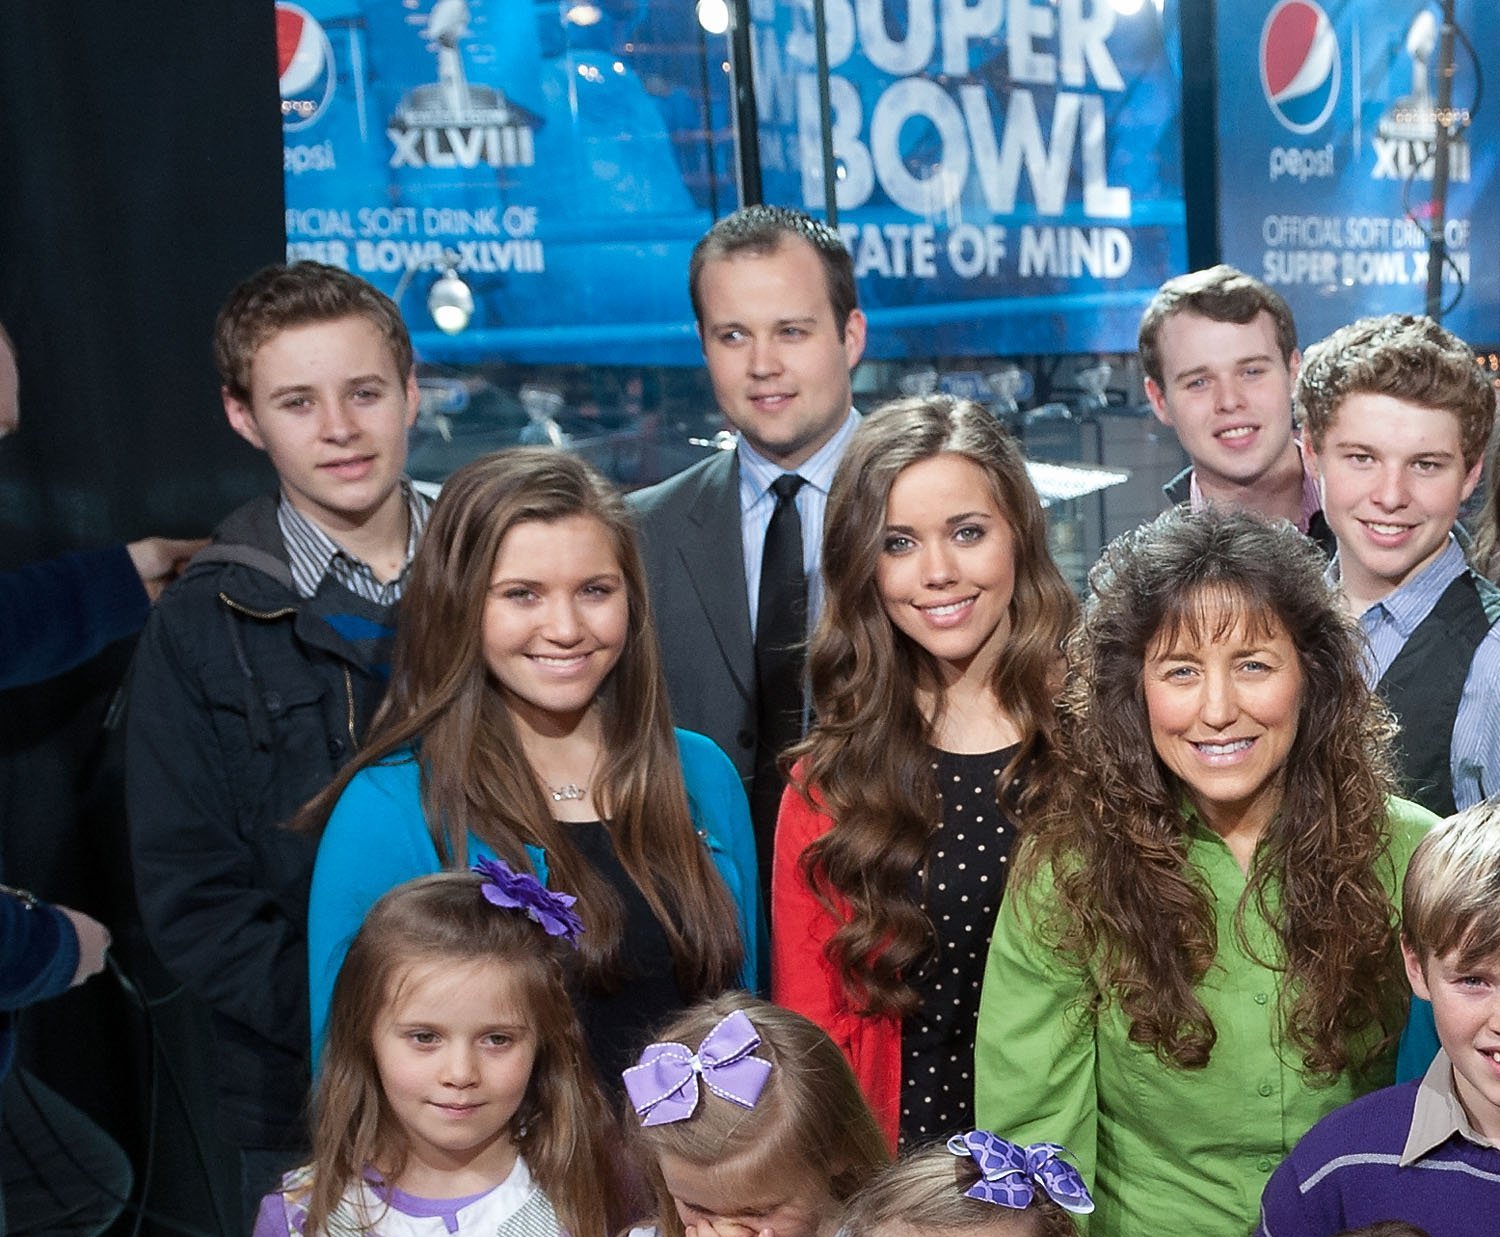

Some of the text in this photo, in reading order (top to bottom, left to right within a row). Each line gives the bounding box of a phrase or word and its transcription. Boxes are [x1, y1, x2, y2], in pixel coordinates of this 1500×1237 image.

[387, 126, 535, 169] XLVIII
[798, 74, 1131, 218] BOWL
[1269, 143, 1334, 183] pepsi
[358, 207, 417, 236] SOFT
[423, 207, 499, 236] DRINK
[503, 206, 537, 237] OF
[1262, 215, 1342, 248] OFFICIAL
[1346, 217, 1390, 248] SOFT
[1444, 219, 1470, 249] OF
[355, 240, 444, 272] BOWL
[457, 240, 545, 273] XLVIII
[840, 224, 1133, 279] TATE OF MIND
[1263, 251, 1337, 284] SUPER
[1342, 251, 1410, 285] BOWL
